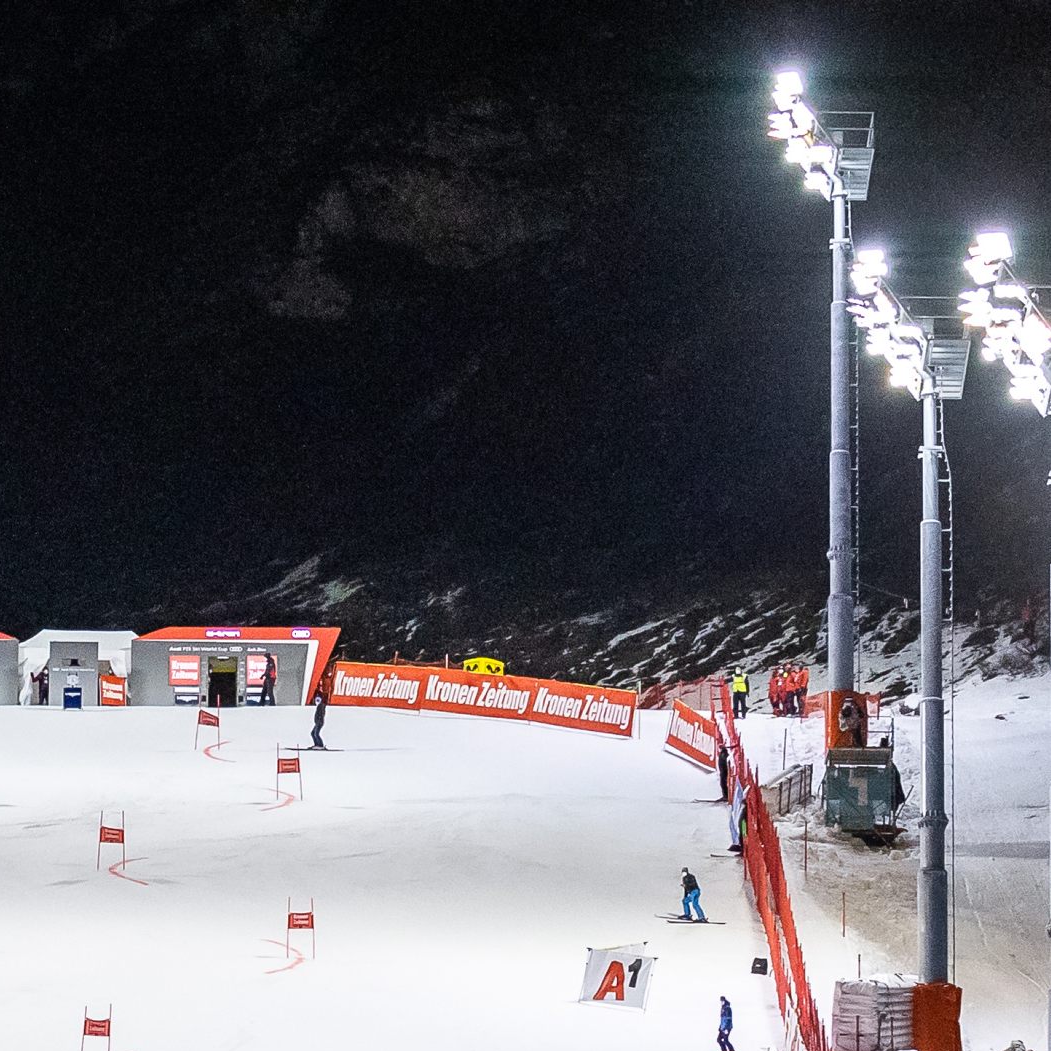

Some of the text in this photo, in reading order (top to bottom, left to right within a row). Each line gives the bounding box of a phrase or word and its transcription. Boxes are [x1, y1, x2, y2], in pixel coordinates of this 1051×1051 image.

[333, 670, 420, 704] Kronen Zeitung
[425, 674, 530, 714] Kronen Zeitung
[533, 687, 631, 730] Kronen Zeitung
[593, 958, 643, 1001] A1
